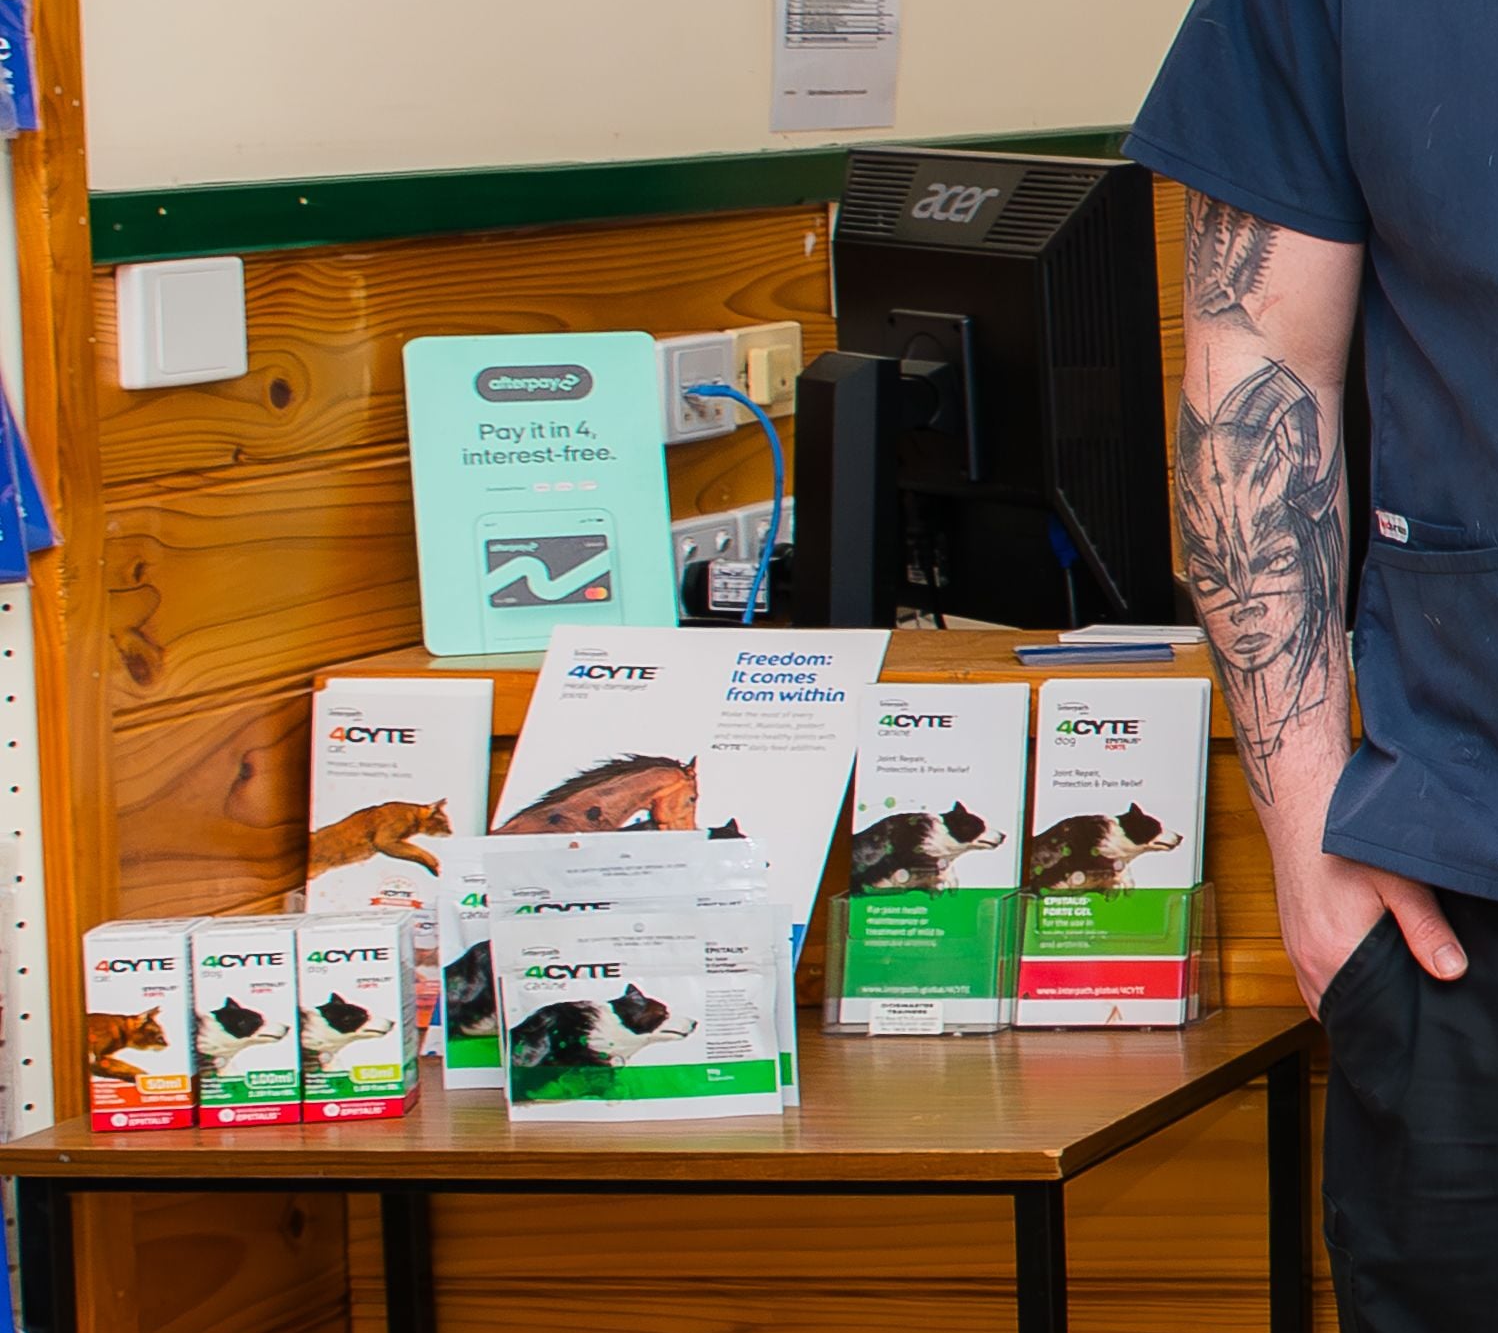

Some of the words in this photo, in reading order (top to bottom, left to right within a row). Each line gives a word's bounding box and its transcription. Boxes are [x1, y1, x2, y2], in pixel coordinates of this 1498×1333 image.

[911, 182, 999, 224] acer
[479, 423, 525, 444] Pay
[531, 422, 545, 439] it
[551, 422, 571, 439] in
[576, 421, 597, 439] 4,
[462, 445, 616, 466] interest-free.
[736, 651, 833, 666] Freedom:
[568, 665, 658, 680] 4CYTE
[731, 670, 746, 684] It
[750, 672, 817, 684] comes
[726, 687, 774, 702] from
[778, 687, 845, 702] within
[879, 715, 952, 728] 4CYTE
[1056, 720, 1139, 735] 4CYTE
[329, 726, 416, 744] 4CYTE
[1055, 736, 1076, 747] dog
[202, 952, 284, 968] 4CYTE
[307, 948, 388, 964] 4CYTE
[95, 957, 175, 973] 4CYTE
[524, 963, 620, 979] 4CYTE
